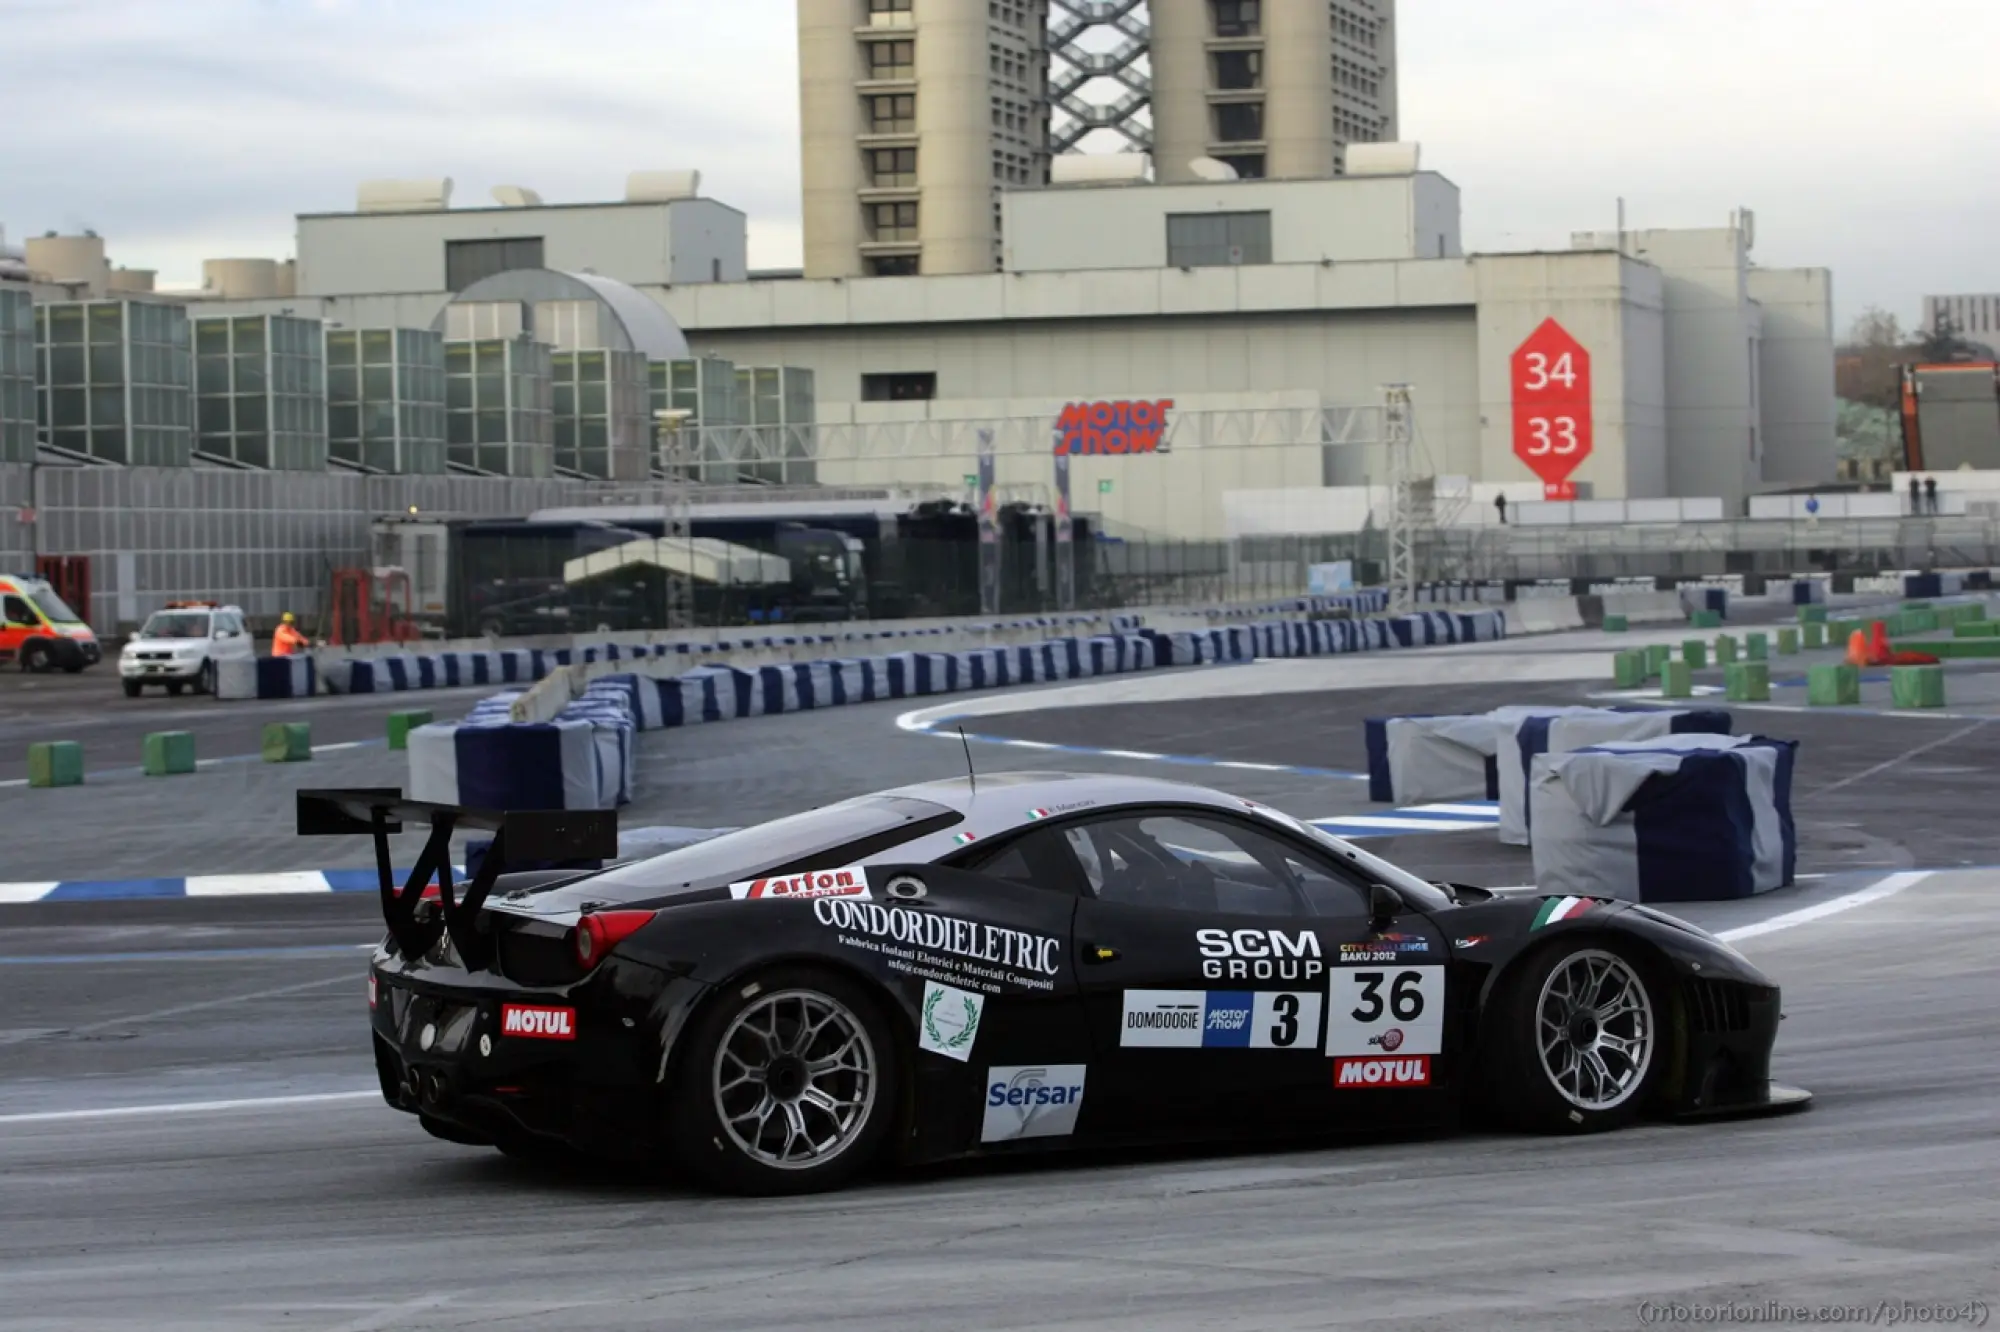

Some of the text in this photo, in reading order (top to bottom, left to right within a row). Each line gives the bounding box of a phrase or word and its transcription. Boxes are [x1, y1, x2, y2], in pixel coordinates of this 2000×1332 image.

[1524, 352, 1577, 390] 34
[1527, 416, 1578, 455] 33
[813, 897, 1060, 976] CONDORDIELETRIC
[1196, 929, 1322, 957] SCM
[1340, 942, 1429, 952] CITY CHALLENGE
[838, 934, 1054, 992] Fabbrica Isolanti Elettrici e Materiali Compositi
[1202, 959, 1322, 979] GROUP
[1340, 951, 1396, 962] BAKU 2012
[1351, 970, 1424, 1023] 36
[505, 1008, 571, 1034] MOTUL
[1269, 993, 1300, 1047] 3
[1338, 1060, 1426, 1084] MOTUL
[988, 1082, 1081, 1106] Sersar
